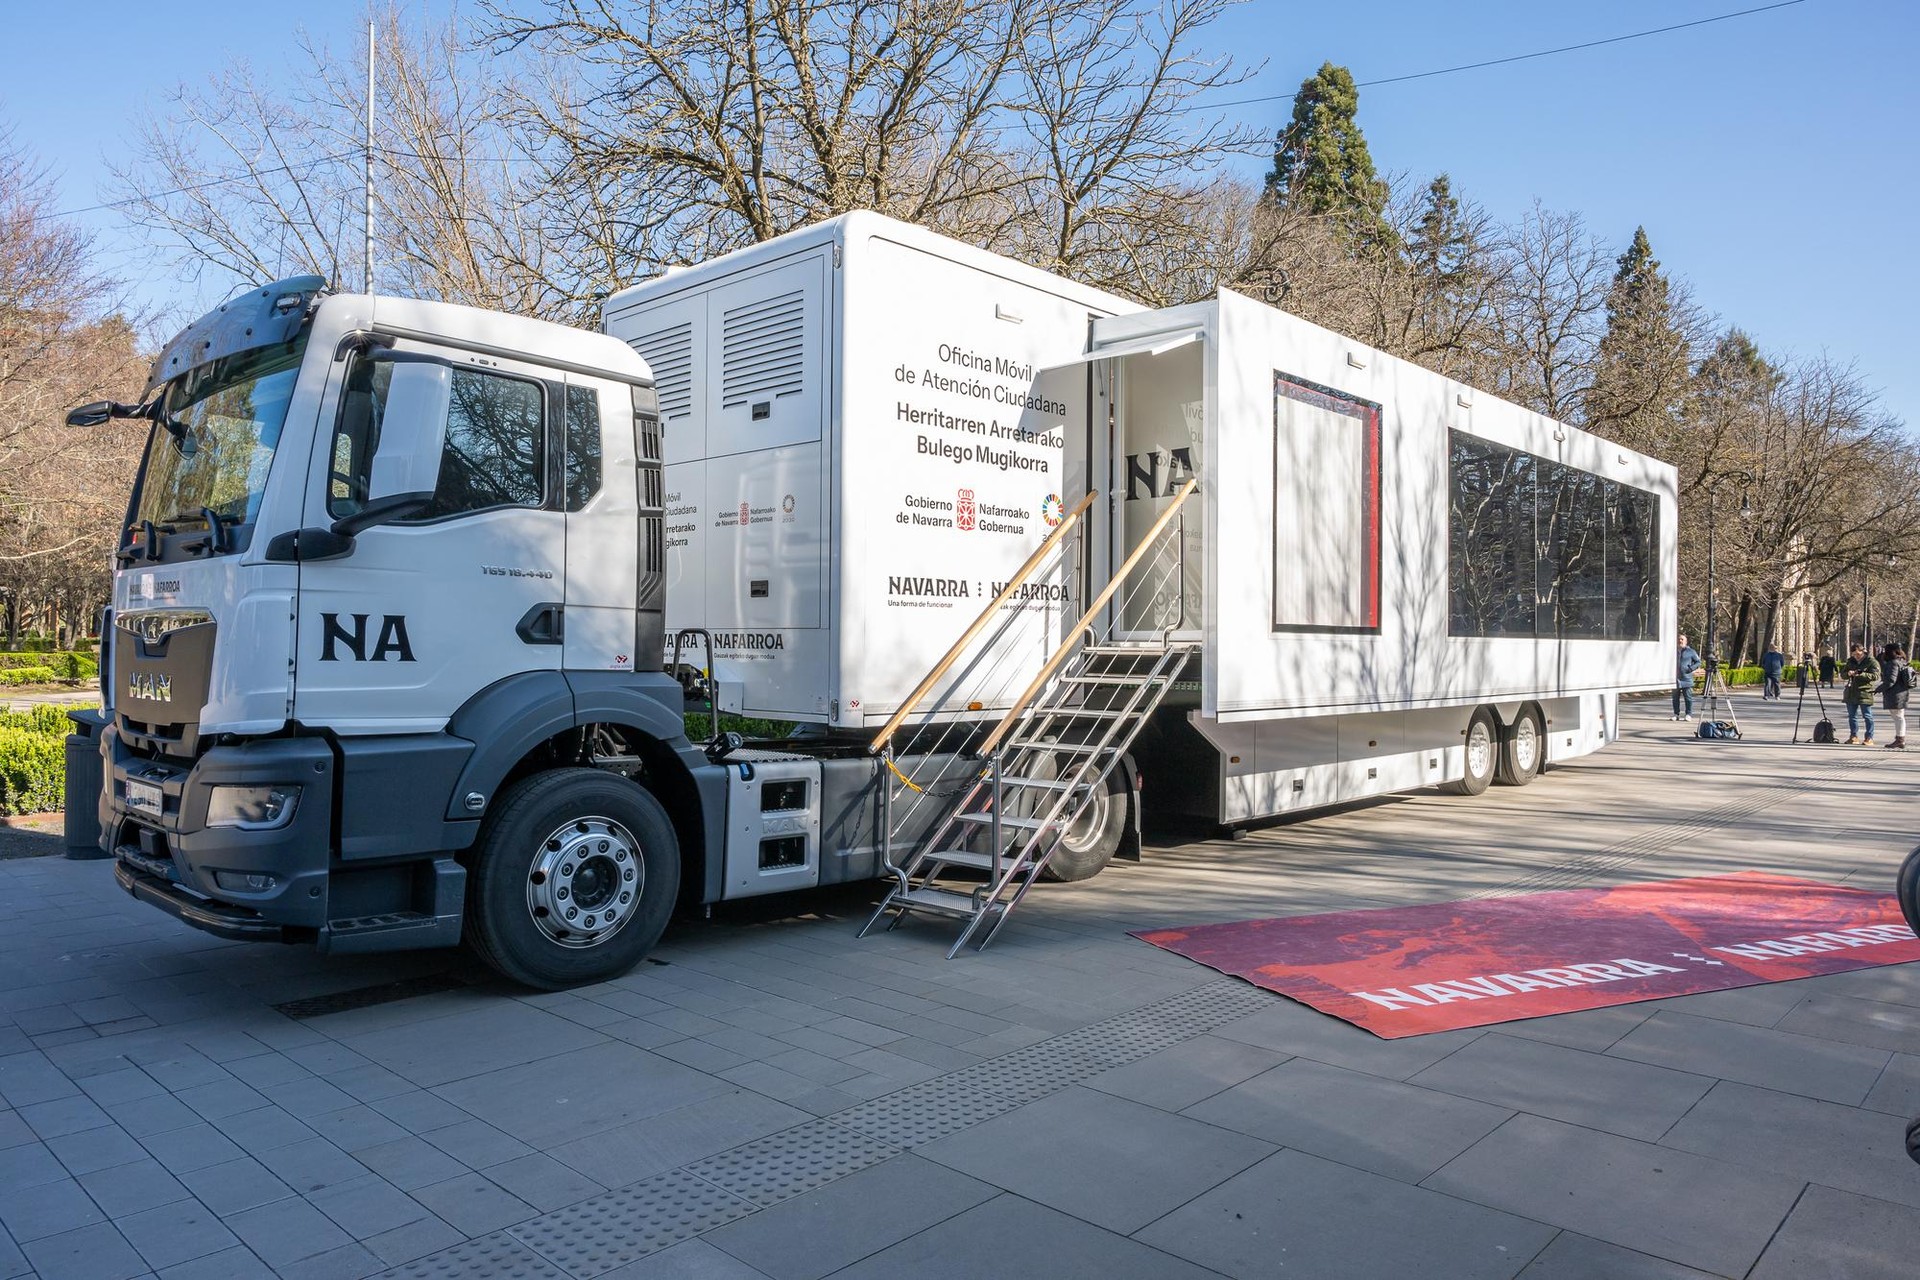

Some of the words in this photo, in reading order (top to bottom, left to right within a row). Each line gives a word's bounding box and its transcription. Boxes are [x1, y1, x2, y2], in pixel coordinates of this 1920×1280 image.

[938, 343, 992, 373] Oficina
[995, 356, 1032, 382] Móvil
[895, 364, 916, 384] de
[922, 369, 991, 400] Atención
[994, 385, 1067, 416] Ciudadana
[897, 401, 986, 436] Herritarren
[989, 419, 1064, 449] Arretarako
[917, 435, 973, 464] Bulego
[976, 445, 1048, 473] Mugikorra
[1125, 447, 1201, 500] NA
[905, 495, 953, 511] Gobierno
[979, 503, 1030, 520] Nafarroako
[896, 511, 910, 524] de
[912, 514, 953, 528] Navarra
[979, 520, 1024, 535] Gobernua
[481, 565, 506, 576] TGS
[509, 568, 553, 579] 18.440
[888, 576, 969, 598] NAVARRA
[887, 599, 899, 607] Una
[319, 613, 418, 662] NA
[714, 633, 784, 649] NAFARROA
[129, 672, 172, 702] MAN
[762, 817, 807, 834] MAN
[1350, 957, 1688, 1012] NAVARRA
